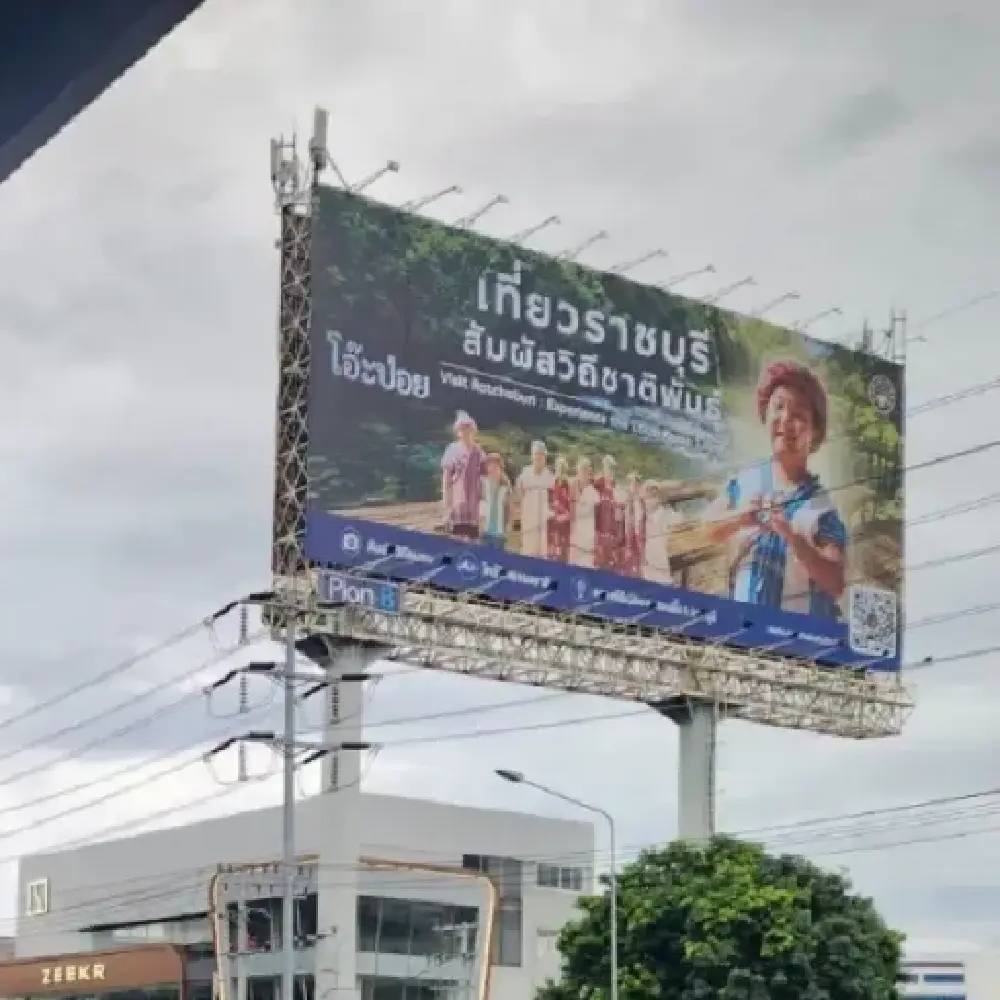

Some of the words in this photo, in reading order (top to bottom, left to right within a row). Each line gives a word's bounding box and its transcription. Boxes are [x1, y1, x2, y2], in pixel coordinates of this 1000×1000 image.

[476, 259, 711, 378] เที่ยวราชบุรี
[41, 963, 105, 984] ZEEKR
